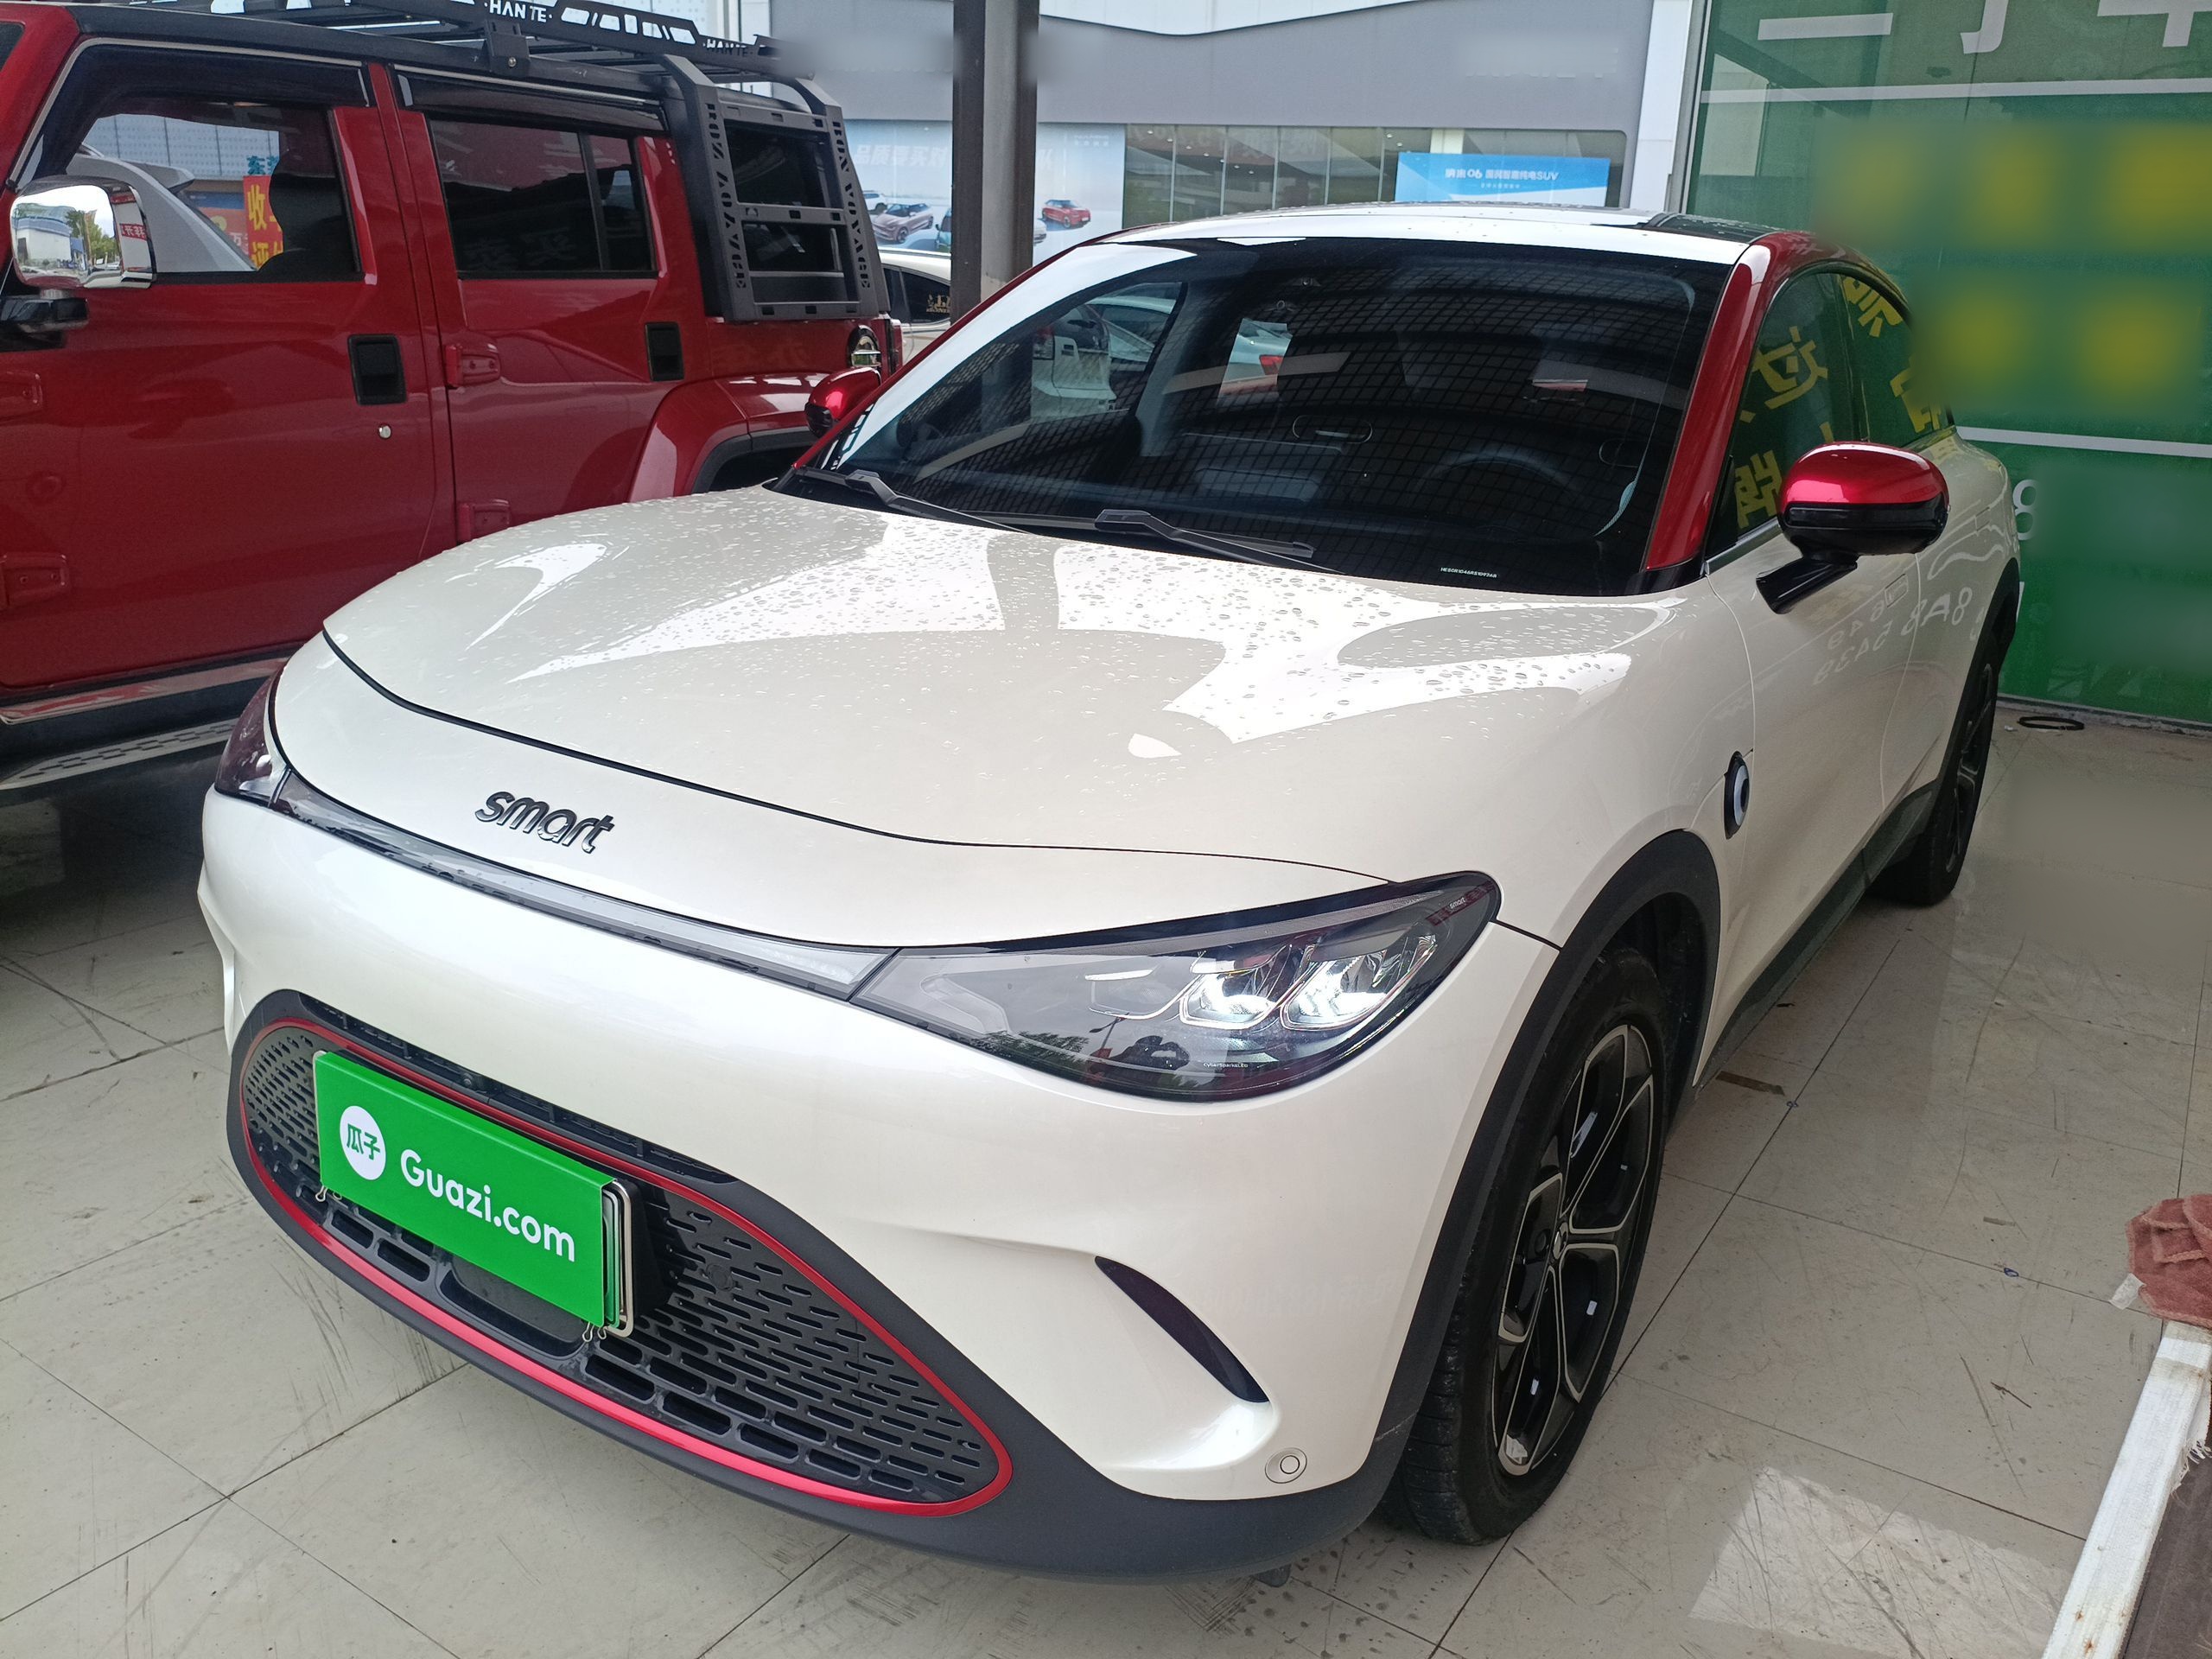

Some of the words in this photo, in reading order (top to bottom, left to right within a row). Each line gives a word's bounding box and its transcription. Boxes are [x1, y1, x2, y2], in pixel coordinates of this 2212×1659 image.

[474, 791, 615, 855] smart
[346, 1122, 381, 1160] 瓜子
[400, 1148, 575, 1262] Guazi.com
